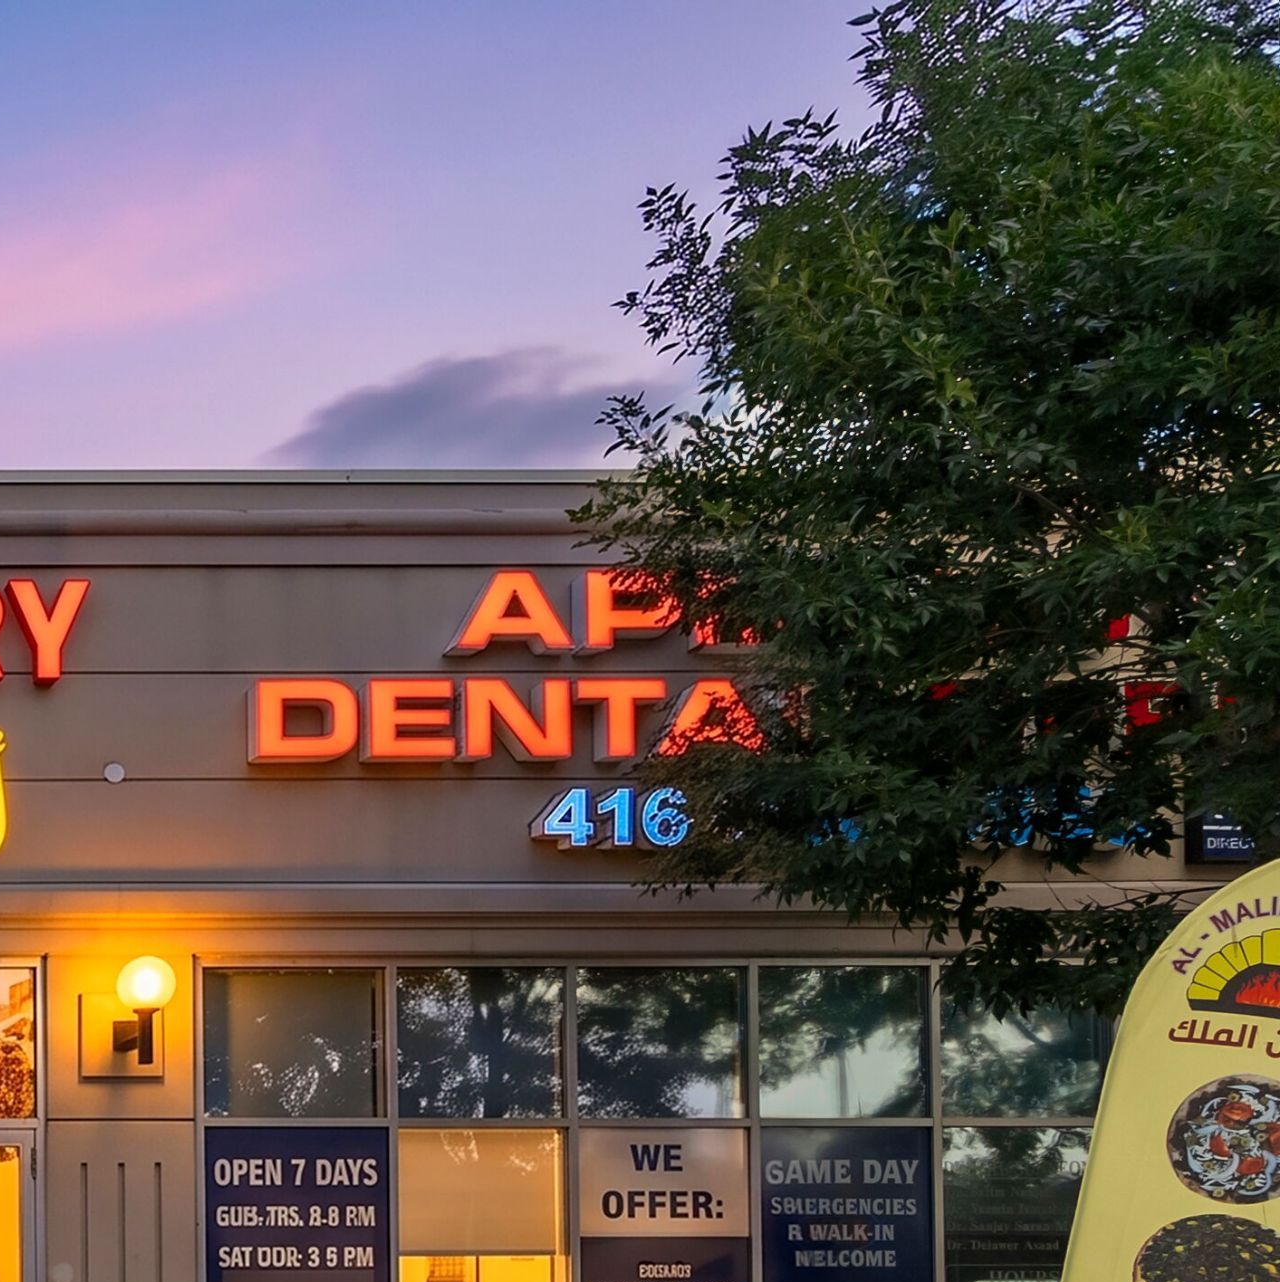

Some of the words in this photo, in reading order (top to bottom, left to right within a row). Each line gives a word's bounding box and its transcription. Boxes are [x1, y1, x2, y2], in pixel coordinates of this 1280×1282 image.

[1171, 947, 1203, 974] AL
[1209, 895, 1280, 933] MALI
[1168, 1019, 1258, 1049] الملك
[214, 1158, 283, 1186] OPEN
[291, 1158, 306, 1186] 7
[315, 1158, 378, 1186] DAYS
[630, 1143, 684, 1172] WE
[863, 1159, 920, 1184] DAY
[601, 1190, 724, 1219] OFFER:
